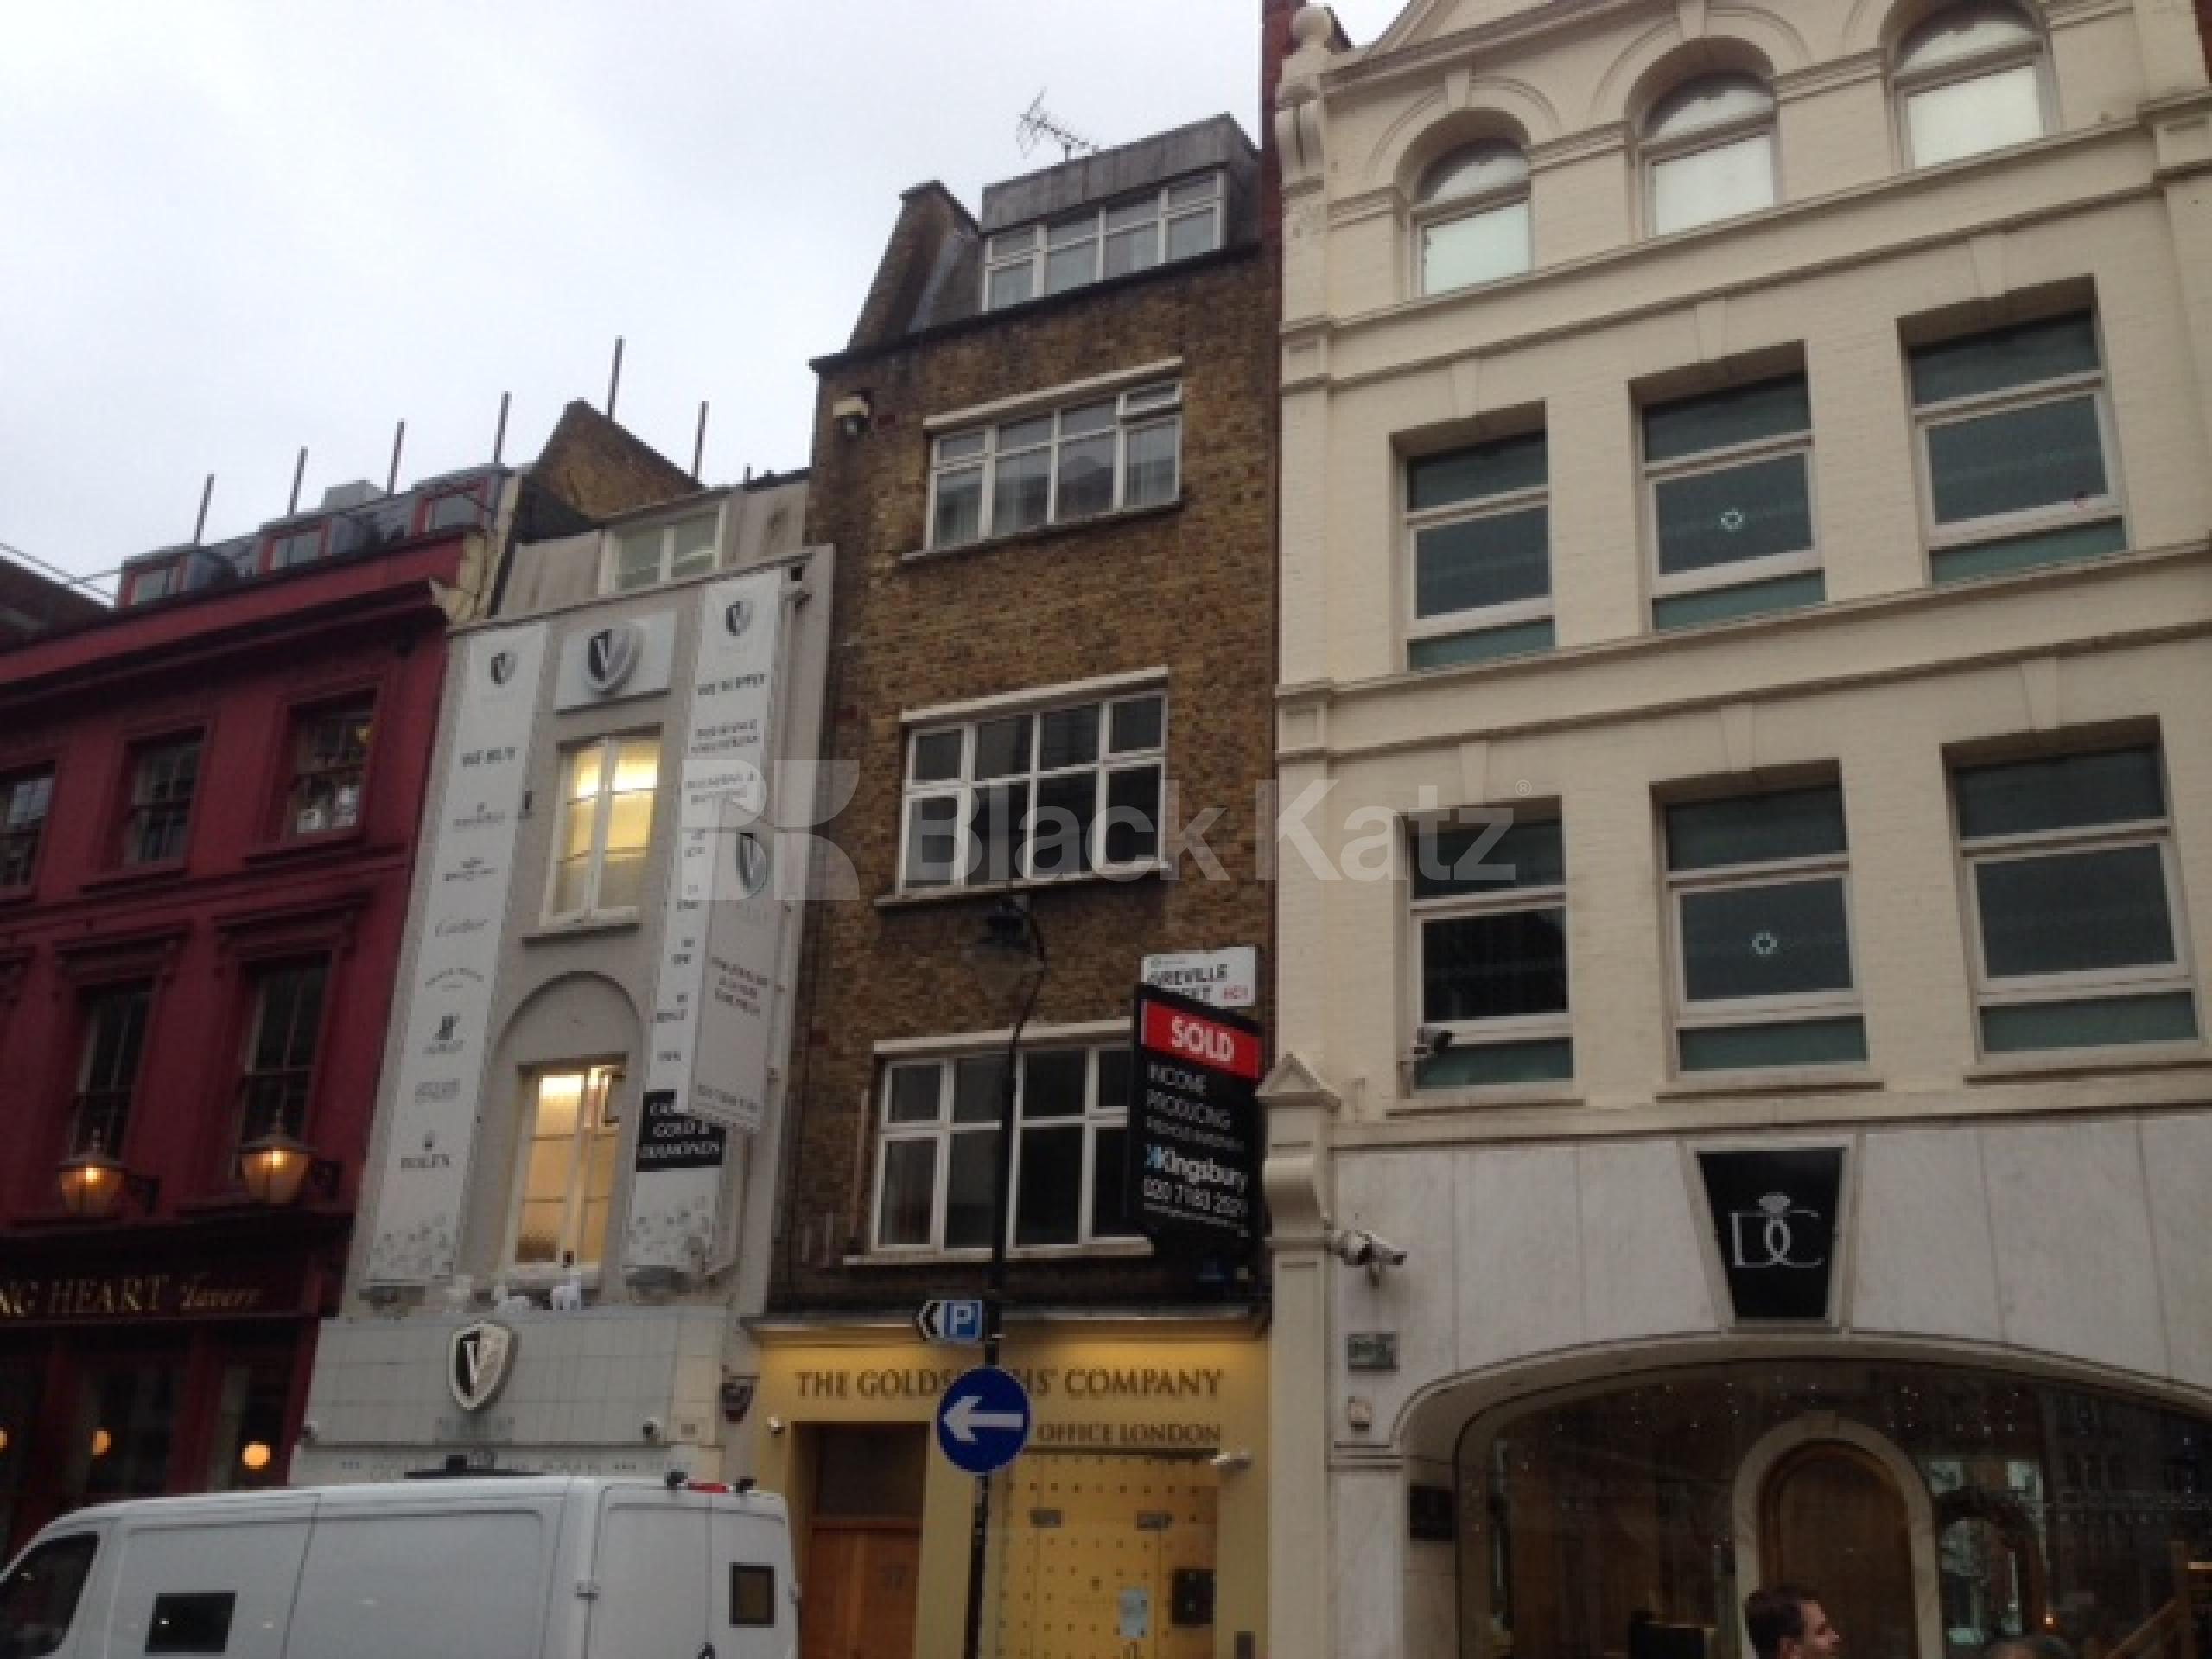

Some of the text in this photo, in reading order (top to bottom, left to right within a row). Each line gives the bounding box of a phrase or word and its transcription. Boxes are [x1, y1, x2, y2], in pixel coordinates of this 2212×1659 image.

[1170, 1015, 1236, 1064] SOLD
[1162, 1147, 1249, 1194] Kingsbury
[48, 1275, 169, 1315] HEART
[796, 1370, 849, 1399] THE
[1064, 1367, 1224, 1398] COMPANY
[1037, 1422, 1221, 1445] OFFICE LONDON
